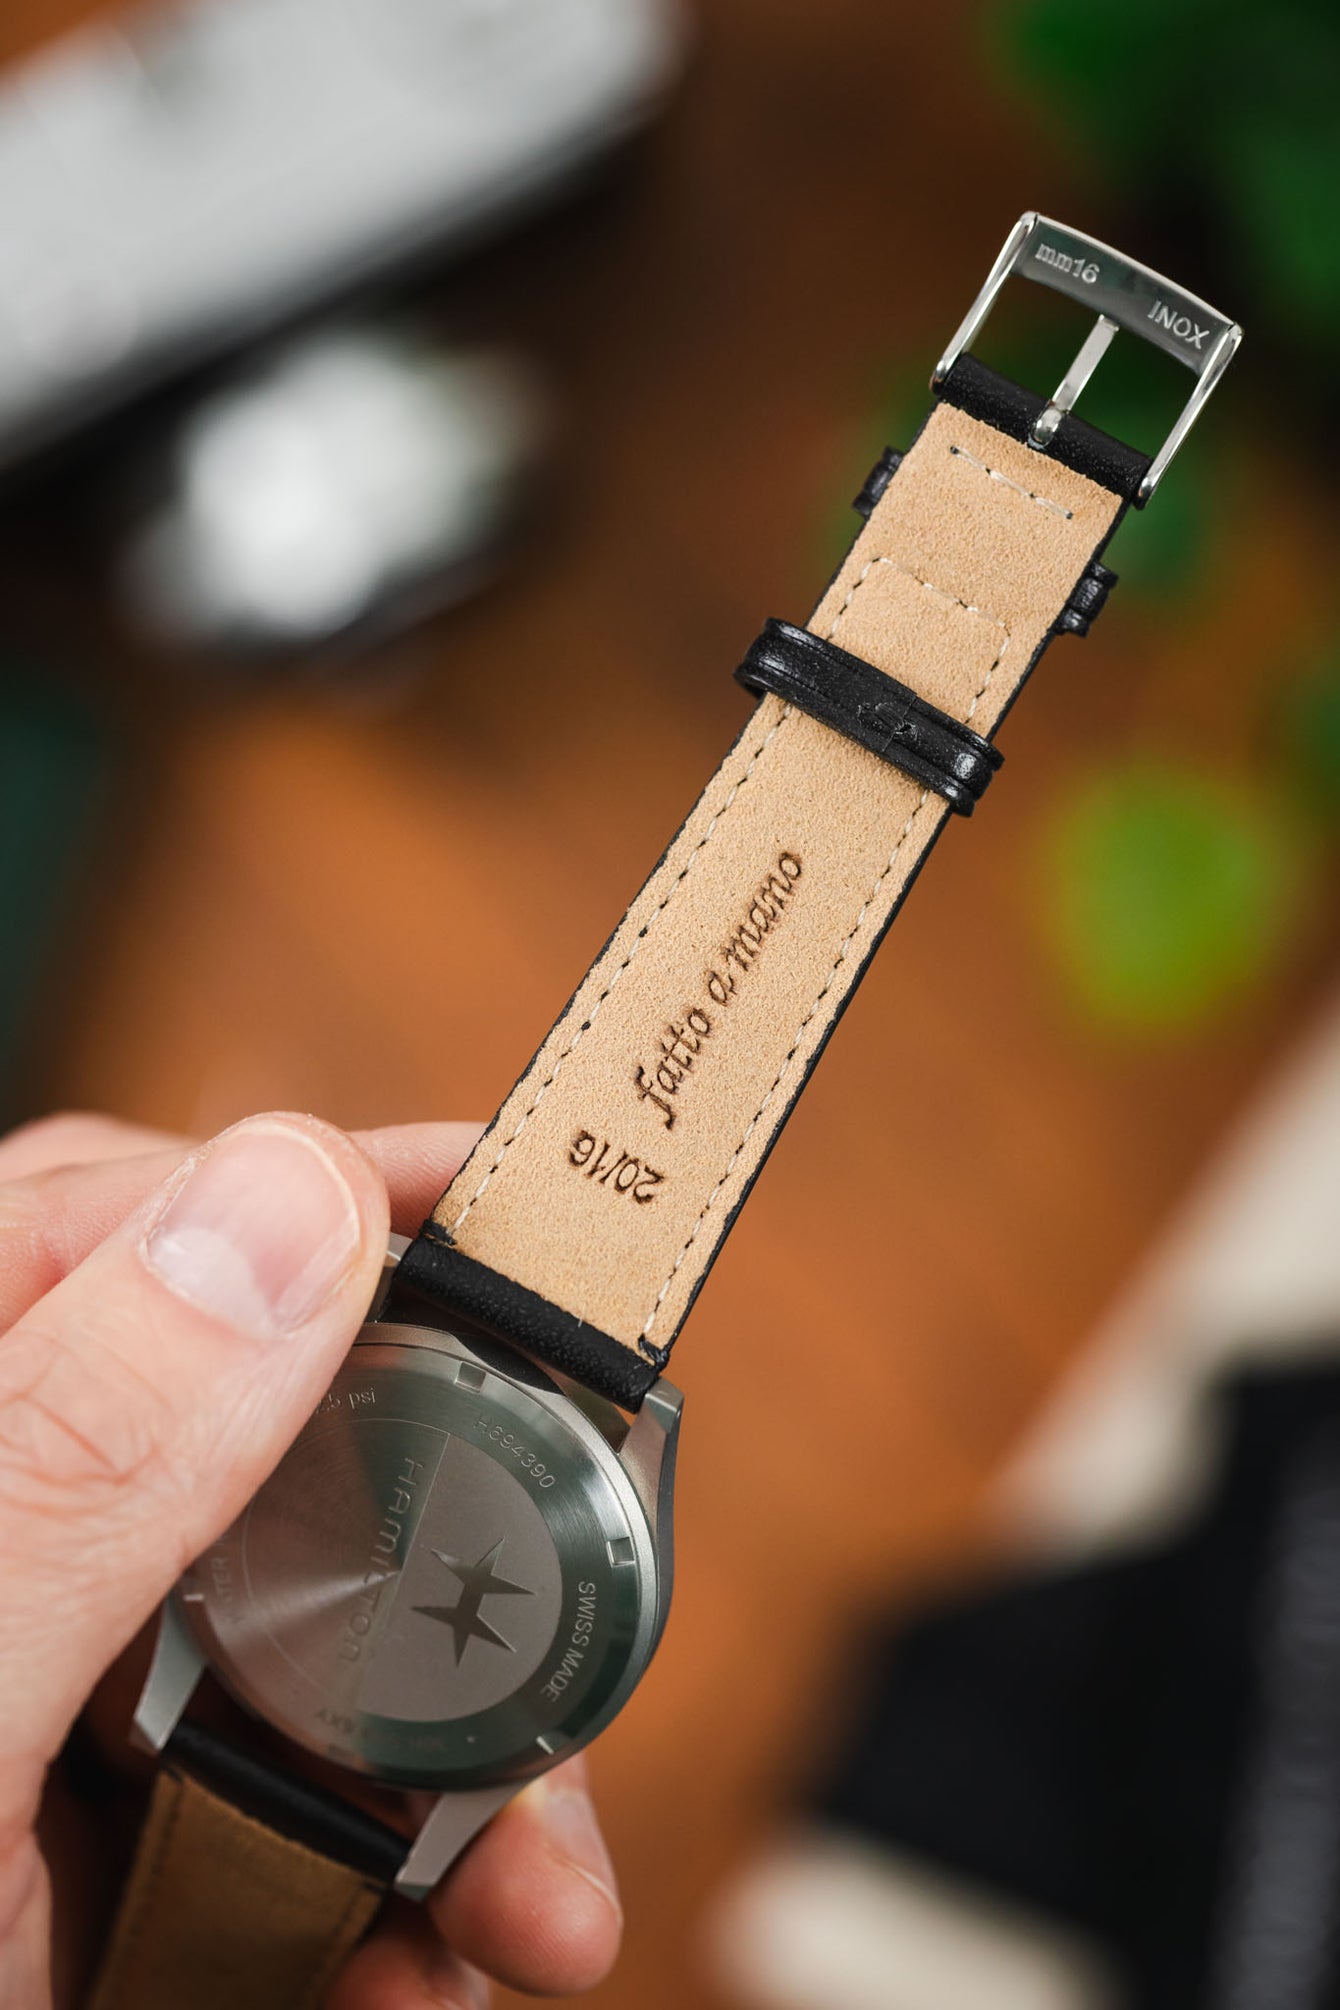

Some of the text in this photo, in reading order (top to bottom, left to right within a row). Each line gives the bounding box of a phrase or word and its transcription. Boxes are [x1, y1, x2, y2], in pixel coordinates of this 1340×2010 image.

[1034, 243, 1101, 285] mm16
[1147, 299, 1211, 350] INOX
[633, 849, 804, 1131] fatto a mano
[567, 1128, 666, 1205] 20/16
[348, 1386, 378, 1411] psi
[539, 1580, 597, 1703] SWISS MADE
